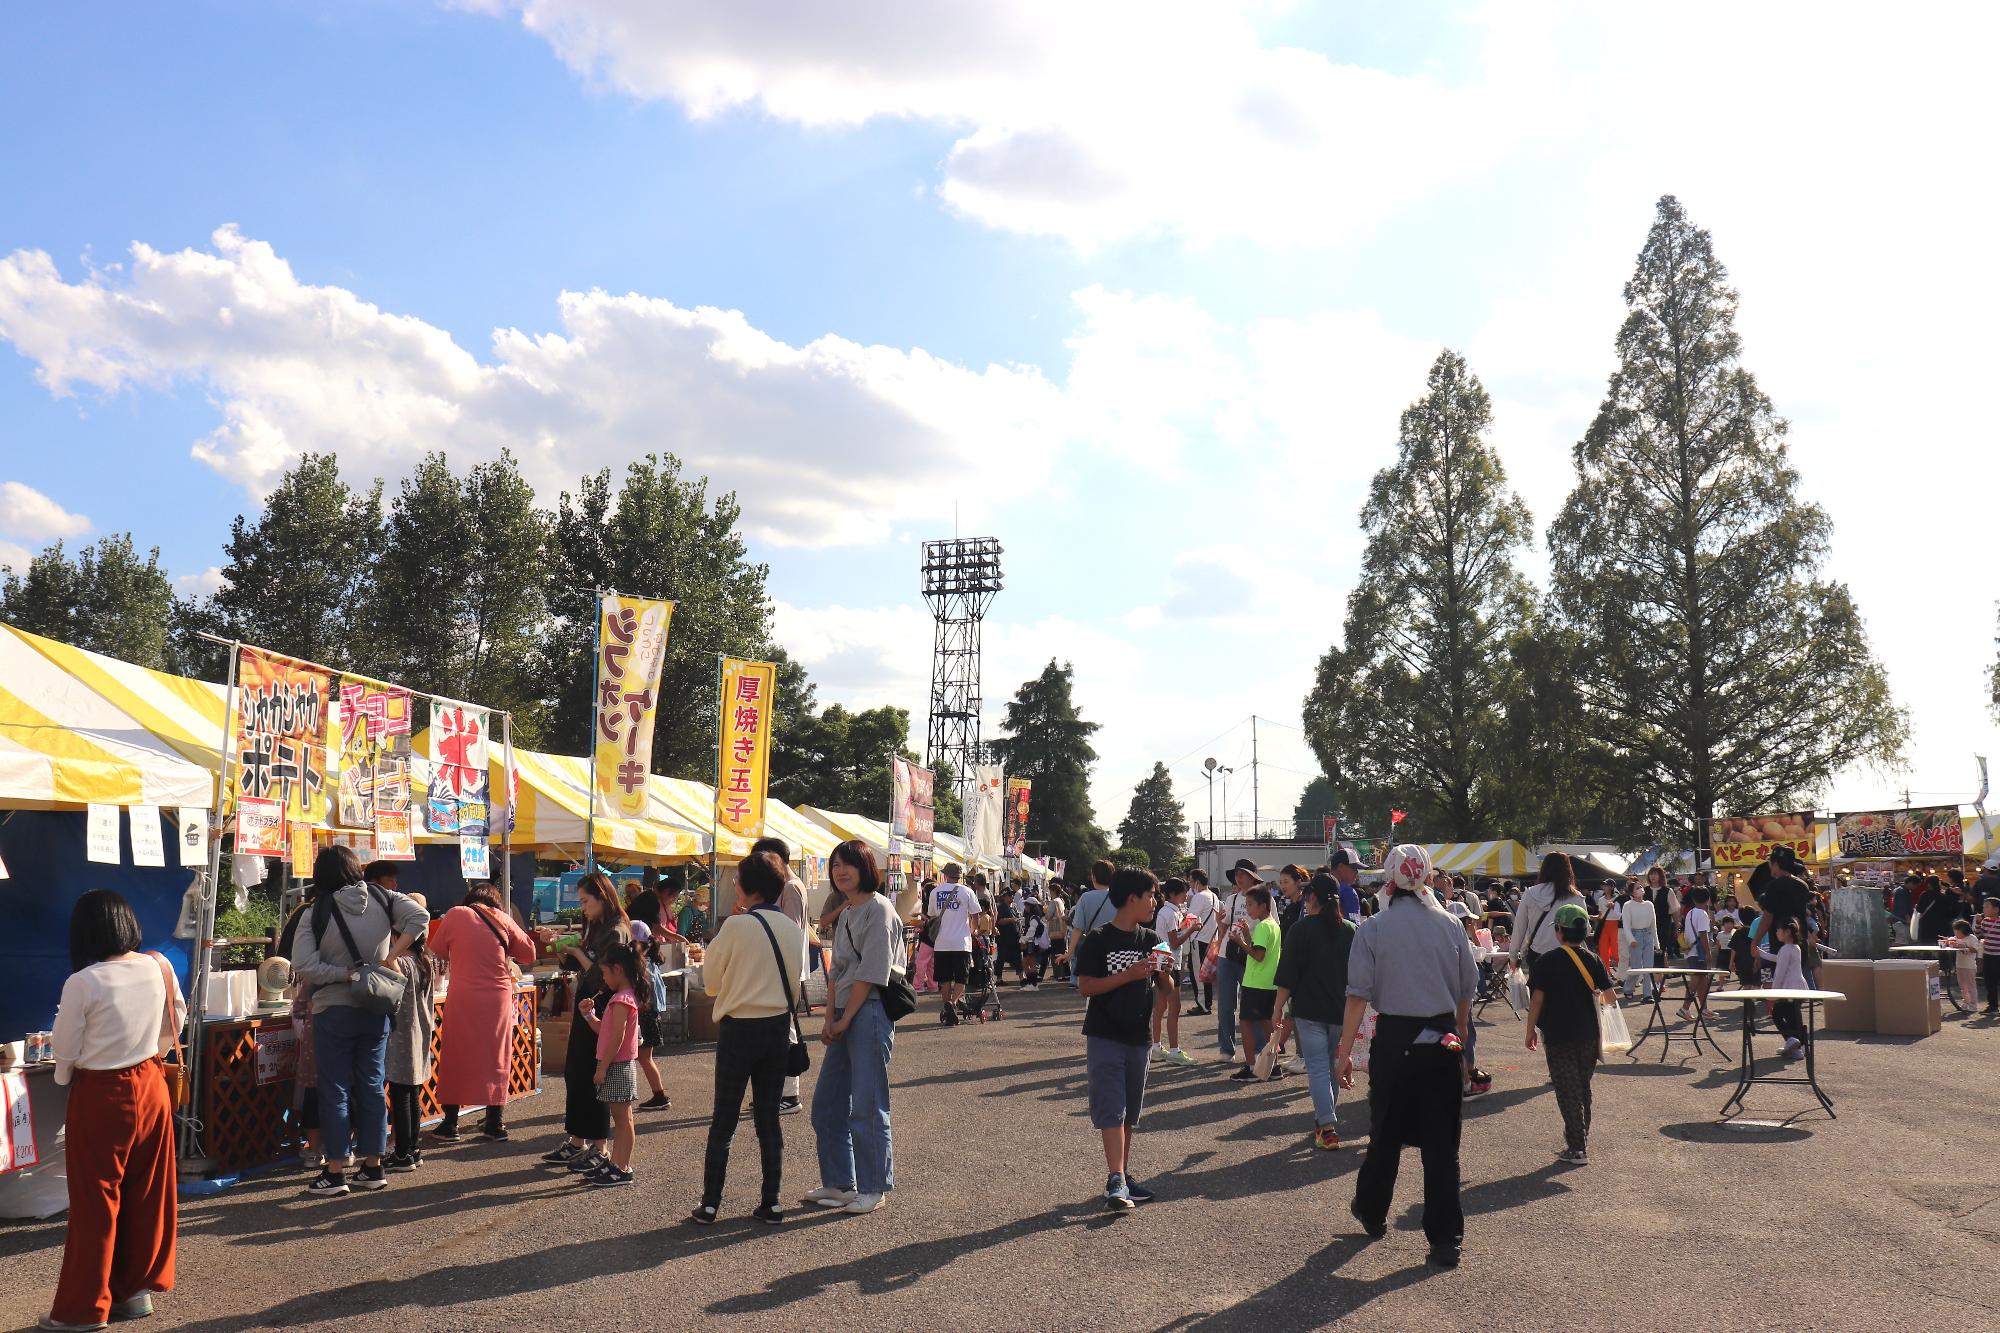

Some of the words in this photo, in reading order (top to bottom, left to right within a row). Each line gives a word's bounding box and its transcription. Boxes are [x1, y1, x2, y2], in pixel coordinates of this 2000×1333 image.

[242, 677, 319, 737] シャカシャカ
[340, 683, 412, 745] チョコ
[241, 734, 320, 811] ポテト
[437, 706, 480, 797] 氷
[726, 675, 760, 823] 厚焼き玉子
[247, 815, 281, 828] ポテトフライ
[339, 757, 412, 826] バナナ
